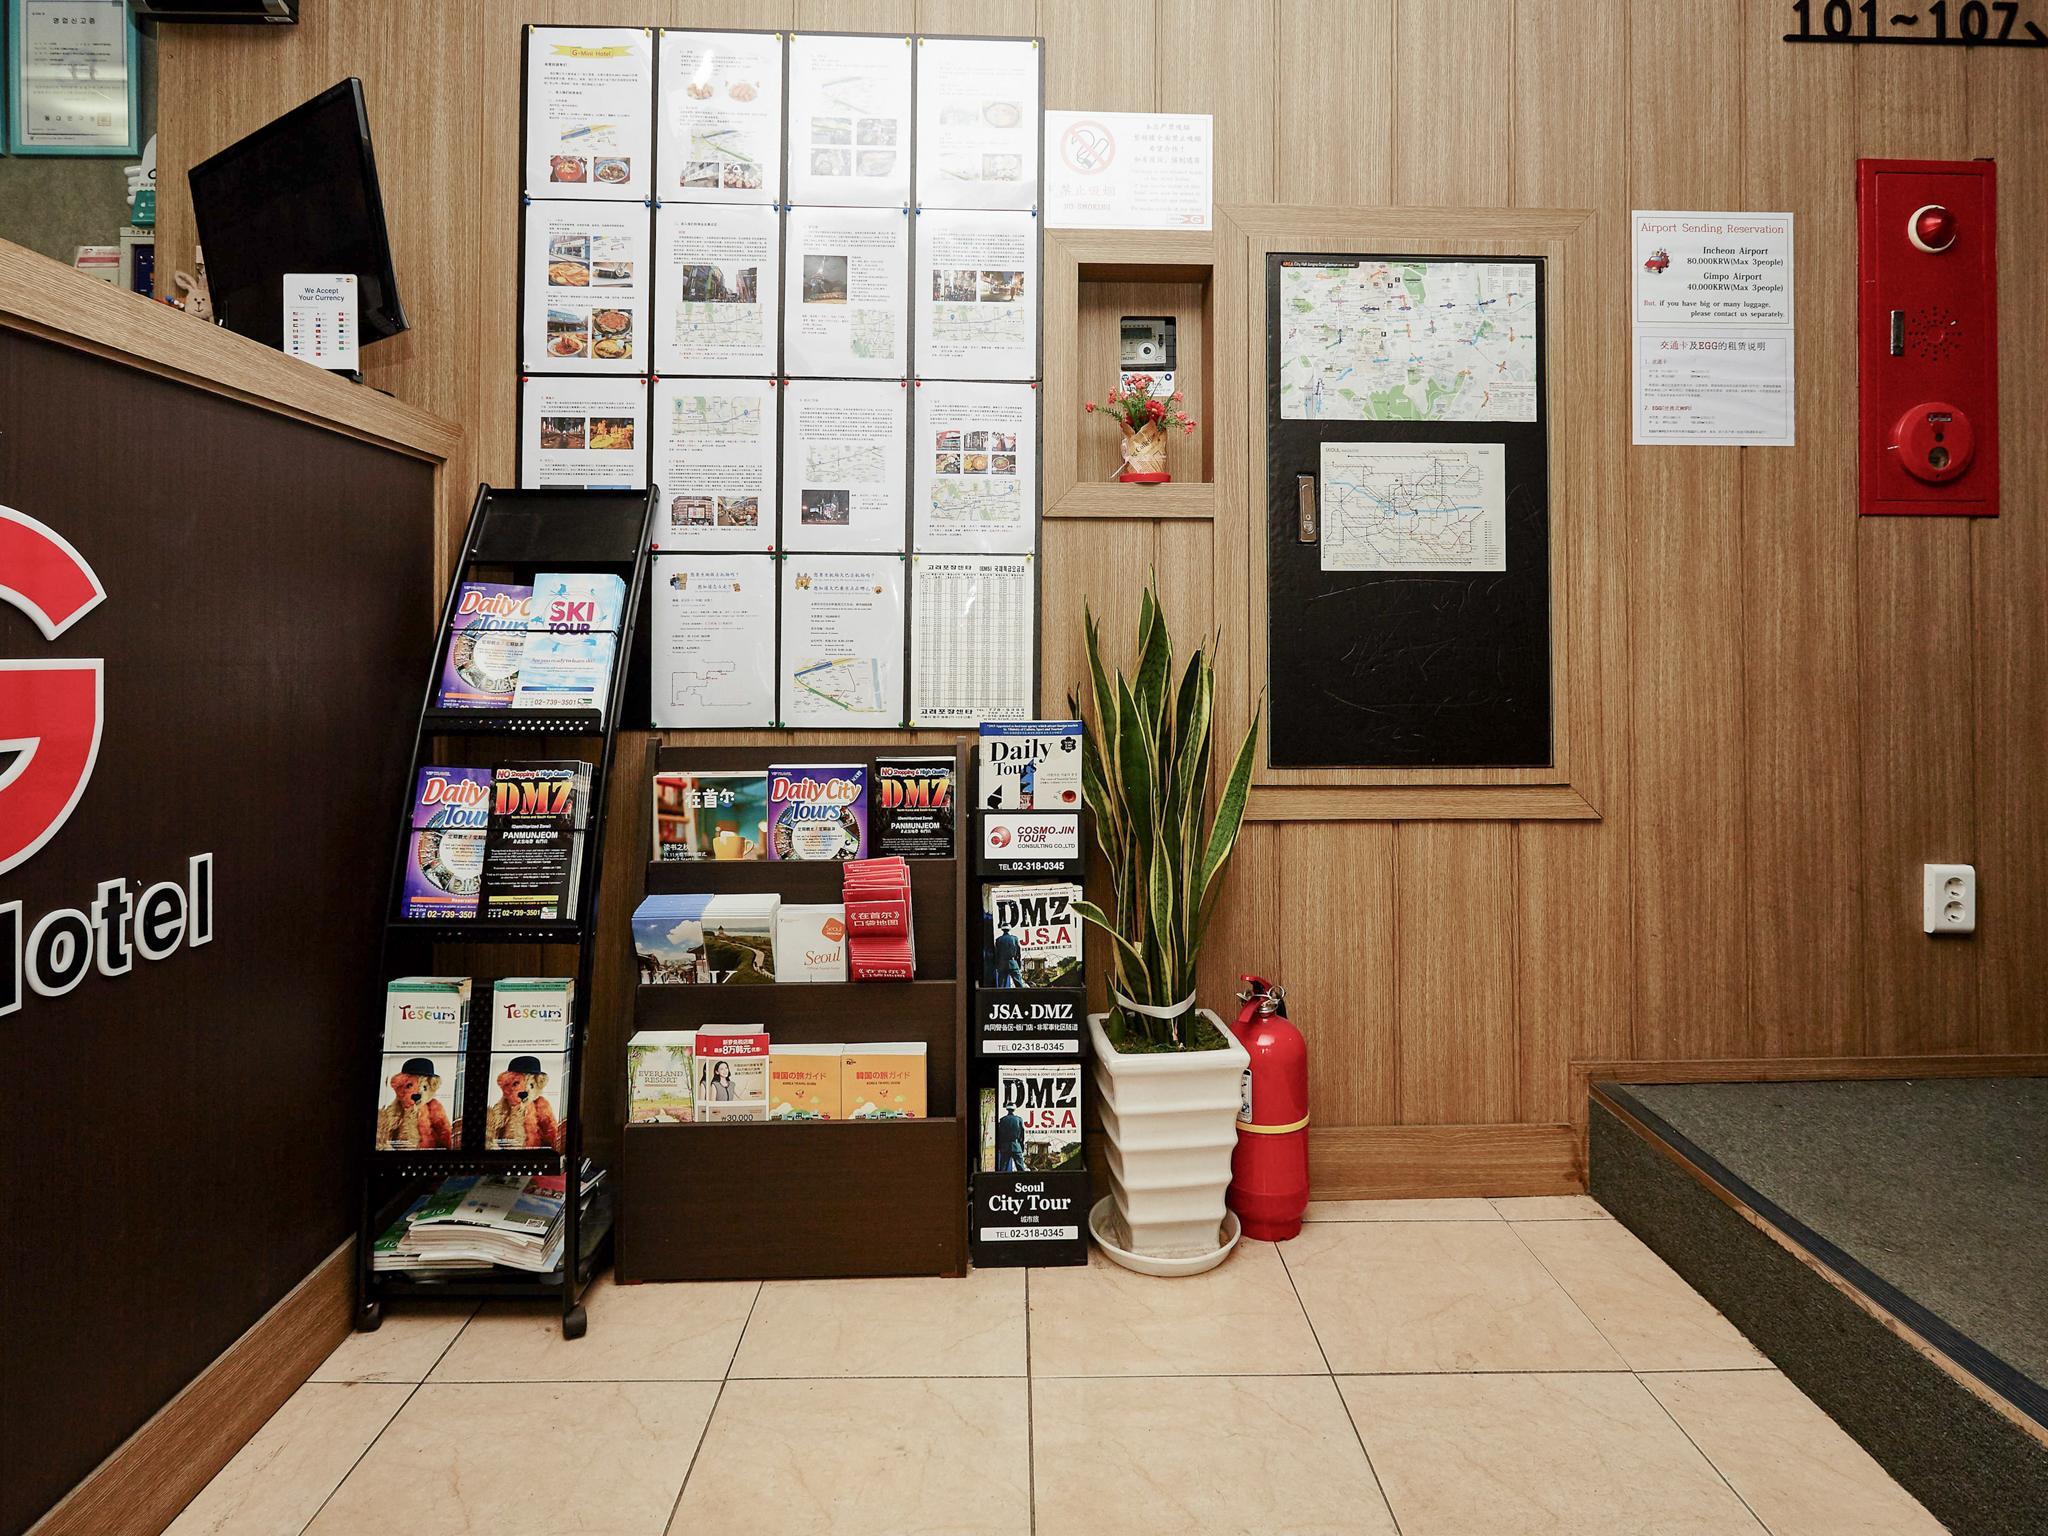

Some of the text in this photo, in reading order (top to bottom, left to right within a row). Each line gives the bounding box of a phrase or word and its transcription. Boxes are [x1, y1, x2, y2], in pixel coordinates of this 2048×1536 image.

[595, 49, 612, 58] Hotel
[1641, 223, 1784, 235] Airport Sending Reservation
[1703, 246, 1769, 256] Incheon Airport
[1752, 258, 1784, 267] 3people)
[1703, 272, 1762, 282] Gimpo Airport
[316, 287, 339, 295] Accept
[1751, 284, 1784, 293] 3people)
[315, 294, 345, 302] Currency
[1700, 300, 1711, 309] big
[1690, 310, 1711, 318] please
[459, 591, 521, 618] Daily
[550, 600, 595, 622] SKI
[549, 622, 591, 635] TOUR
[534, 698, 576, 706] 02-739-3501
[989, 739, 1053, 763] Daily
[496, 769, 510, 779] NO
[511, 770, 536, 779] Shopping
[540, 769, 553, 779] High
[553, 769, 574, 778] Quality
[880, 767, 893, 776] NO
[894, 768, 915, 777] Shopping
[919, 768, 931, 777] High
[931, 767, 950, 776] Quality
[993, 762, 1037, 776] Tours
[422, 778, 490, 804] Daily
[771, 777, 862, 804] Daily City
[880, 779, 950, 808] DMZ
[494, 782, 574, 815] DMZ
[685, 788, 735, 809] 在首尔
[791, 800, 842, 821] Tours
[503, 831, 559, 839] PANMUNJEOM
[1017, 826, 1075, 835] COSMO.JIN
[1018, 834, 1047, 842] TOUR
[427, 910, 477, 918] 02-739-3501
[502, 909, 541, 917] 02-739-3501
[996, 896, 1071, 929] DMZ
[1019, 926, 1072, 946] J.S.A
[804, 946, 841, 966] Seoul
[399, 1004, 456, 1020] Teseum
[503, 1003, 562, 1019] Teseum
[772, 1071, 827, 1080] 韓国の旅ガイド
[856, 1071, 911, 1080] 韓国の旅ガイド
[1002, 1077, 1077, 1108] DMZ
[1024, 1109, 1076, 1128] J.S.A
[1014, 1181, 1044, 1193] Seoul
[988, 1194, 1071, 1215] City Tour
